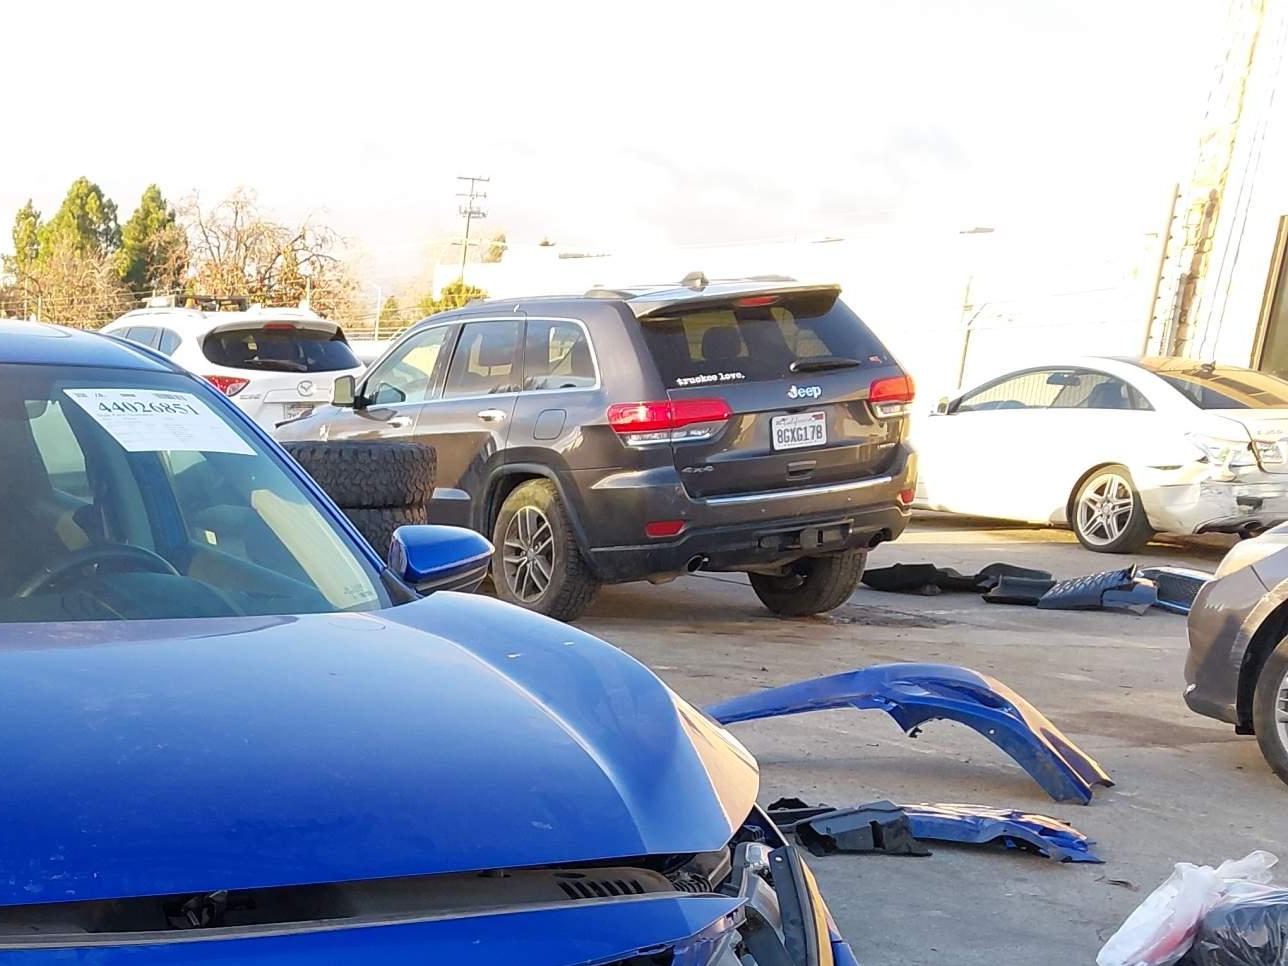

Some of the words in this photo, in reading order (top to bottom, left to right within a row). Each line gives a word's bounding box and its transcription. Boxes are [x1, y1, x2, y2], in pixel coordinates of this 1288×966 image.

[787, 385, 822, 398] Jeep
[98, 401, 200, 416] 44026851
[776, 424, 823, 444] 8GXG178
